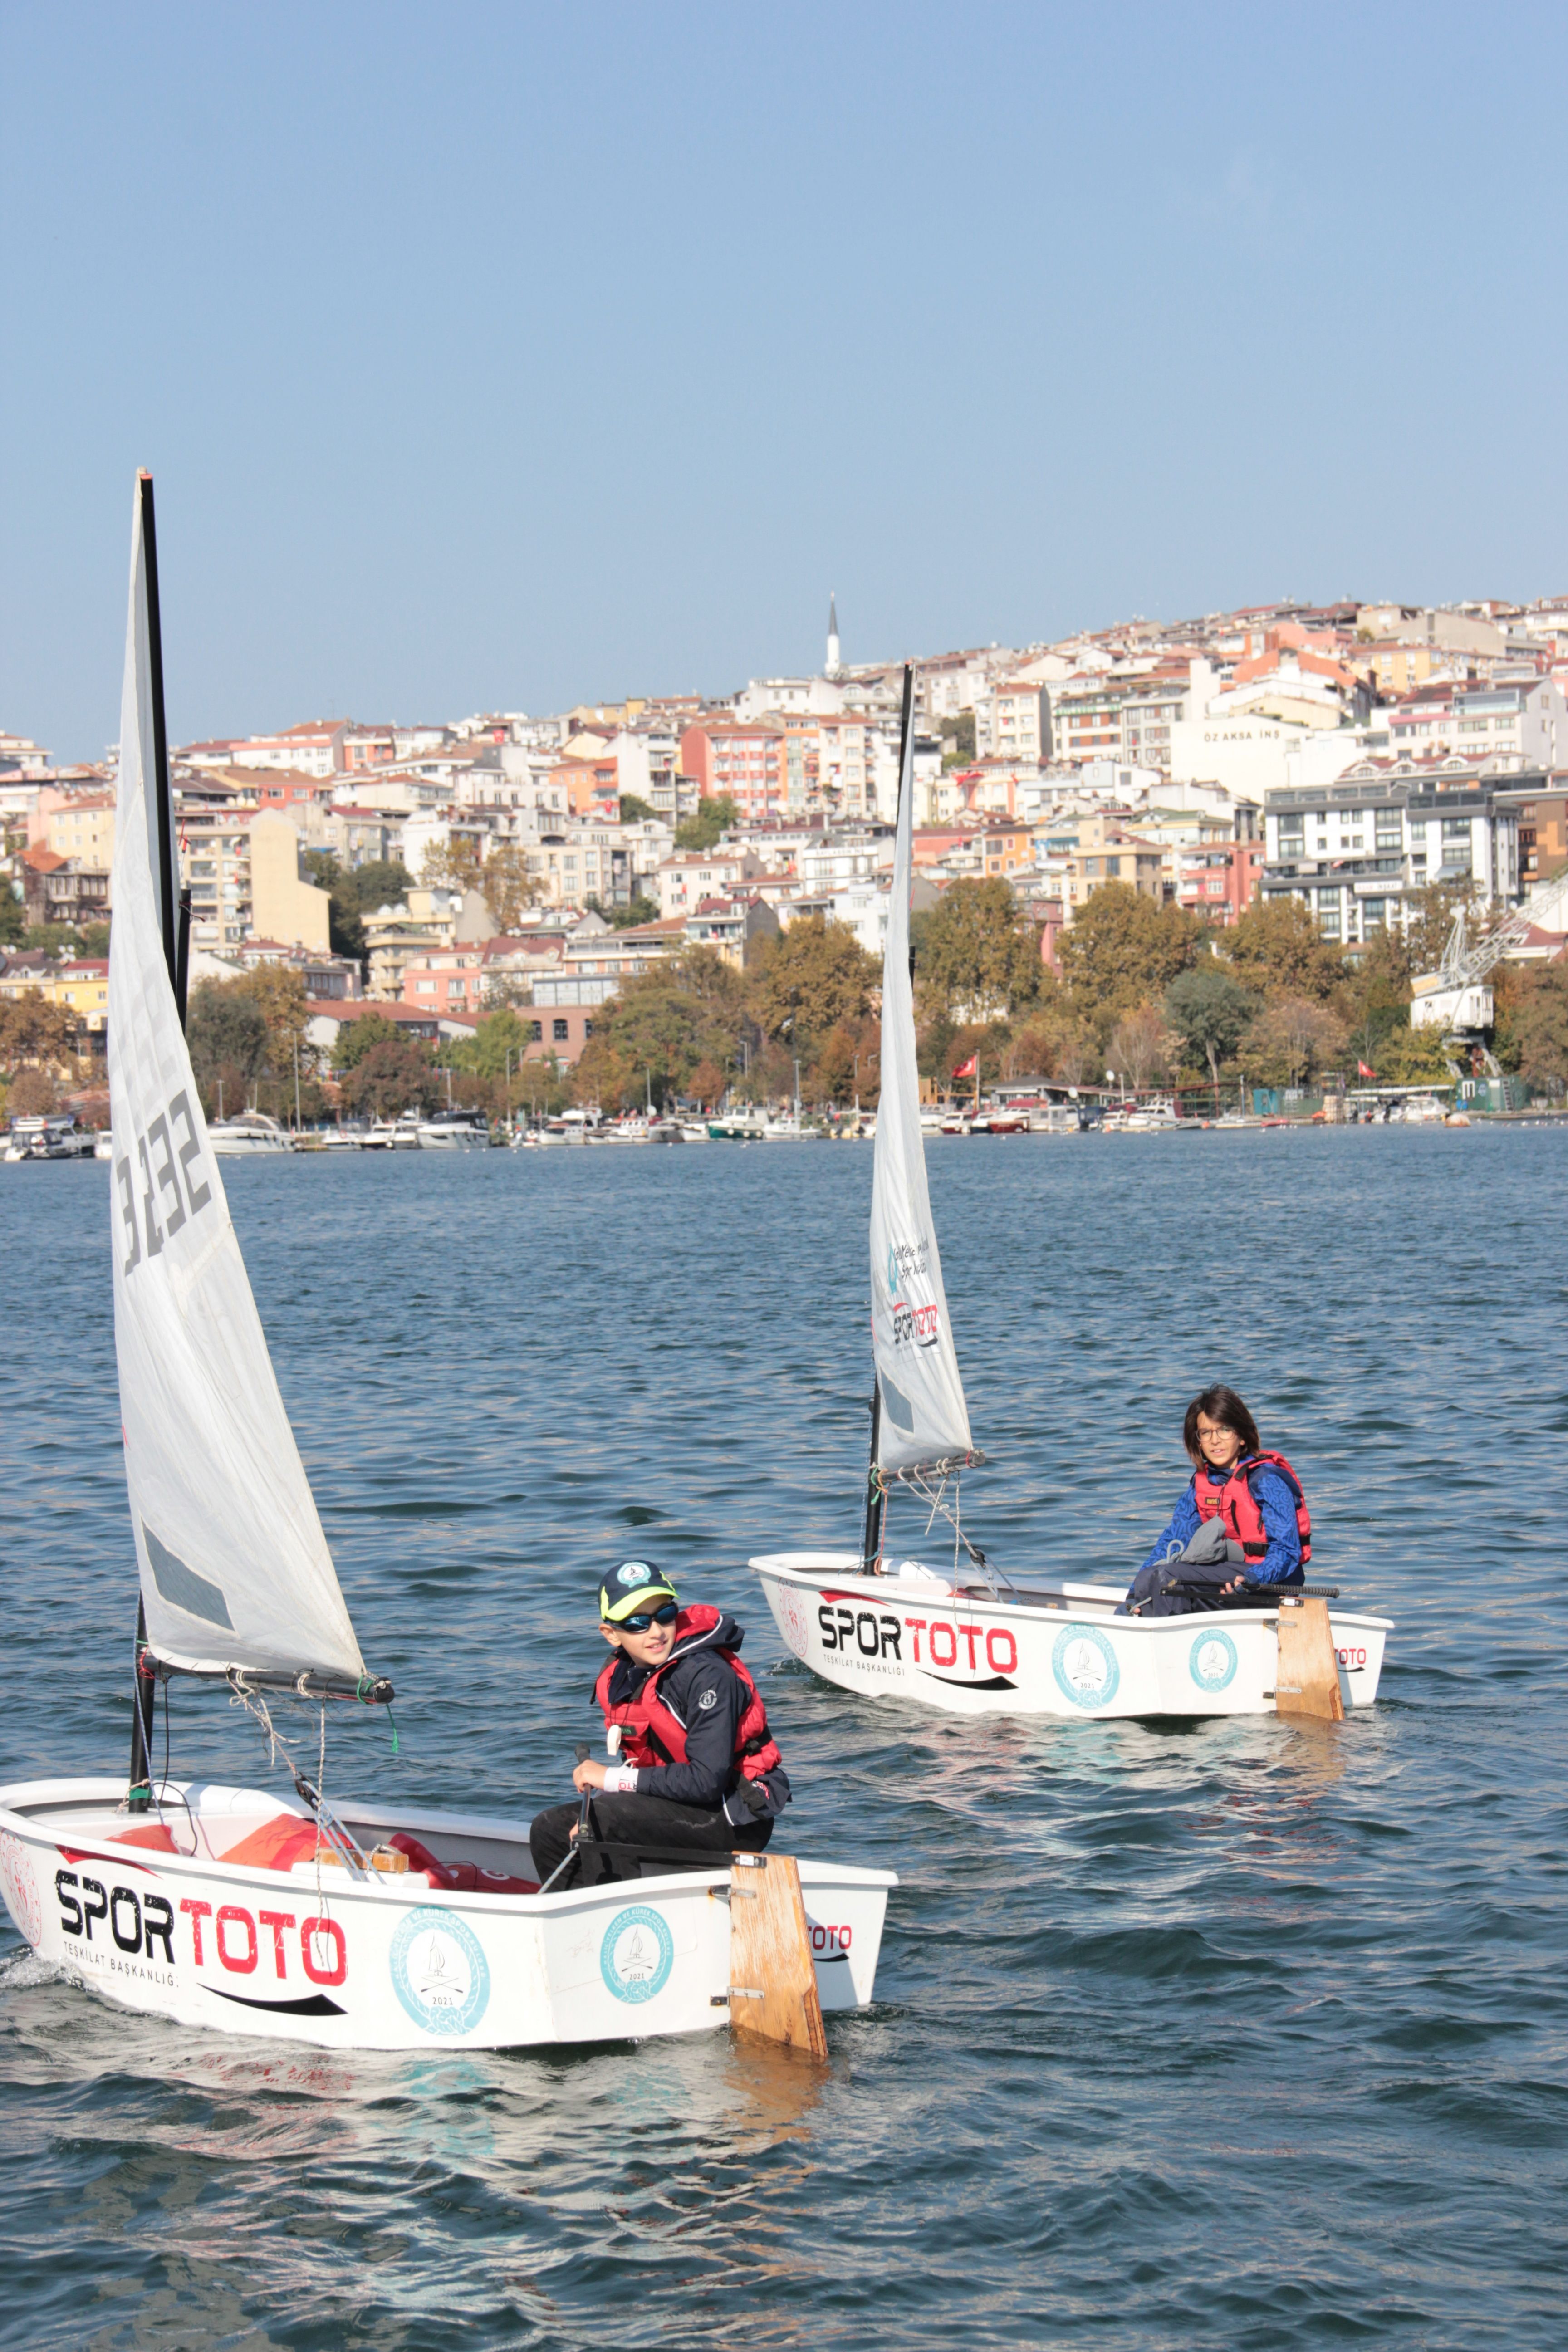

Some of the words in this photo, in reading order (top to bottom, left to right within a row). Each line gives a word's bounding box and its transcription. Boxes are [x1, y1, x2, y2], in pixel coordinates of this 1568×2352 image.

[1223, 732, 1252, 740] AKSA
[823, 1654, 853, 1667] TEŞKİLAT
[857, 1661, 904, 1676] BAŞKANLIĞI
[64, 1941, 105, 1966] TEŞKİLAT
[111, 1958, 179, 1988] BAŞKANLIĞ
[432, 1997, 453, 2005] 2021
